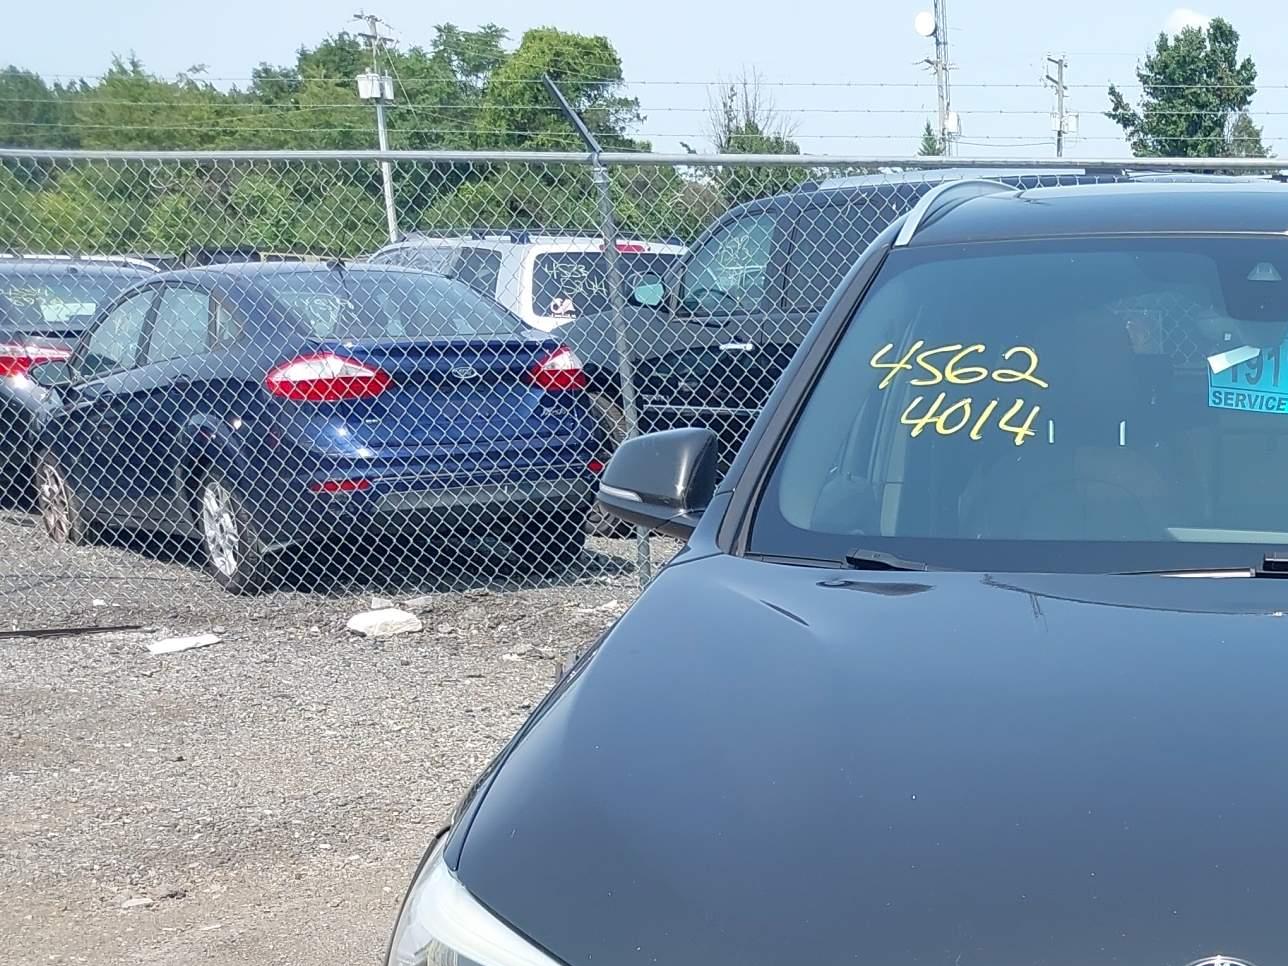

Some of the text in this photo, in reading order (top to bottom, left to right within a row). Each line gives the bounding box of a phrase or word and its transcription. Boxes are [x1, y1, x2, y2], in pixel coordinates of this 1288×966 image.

[870, 340, 1049, 390] 4562
[900, 392, 1040, 446] 4014
[1211, 390, 1288, 411] SERVICE
